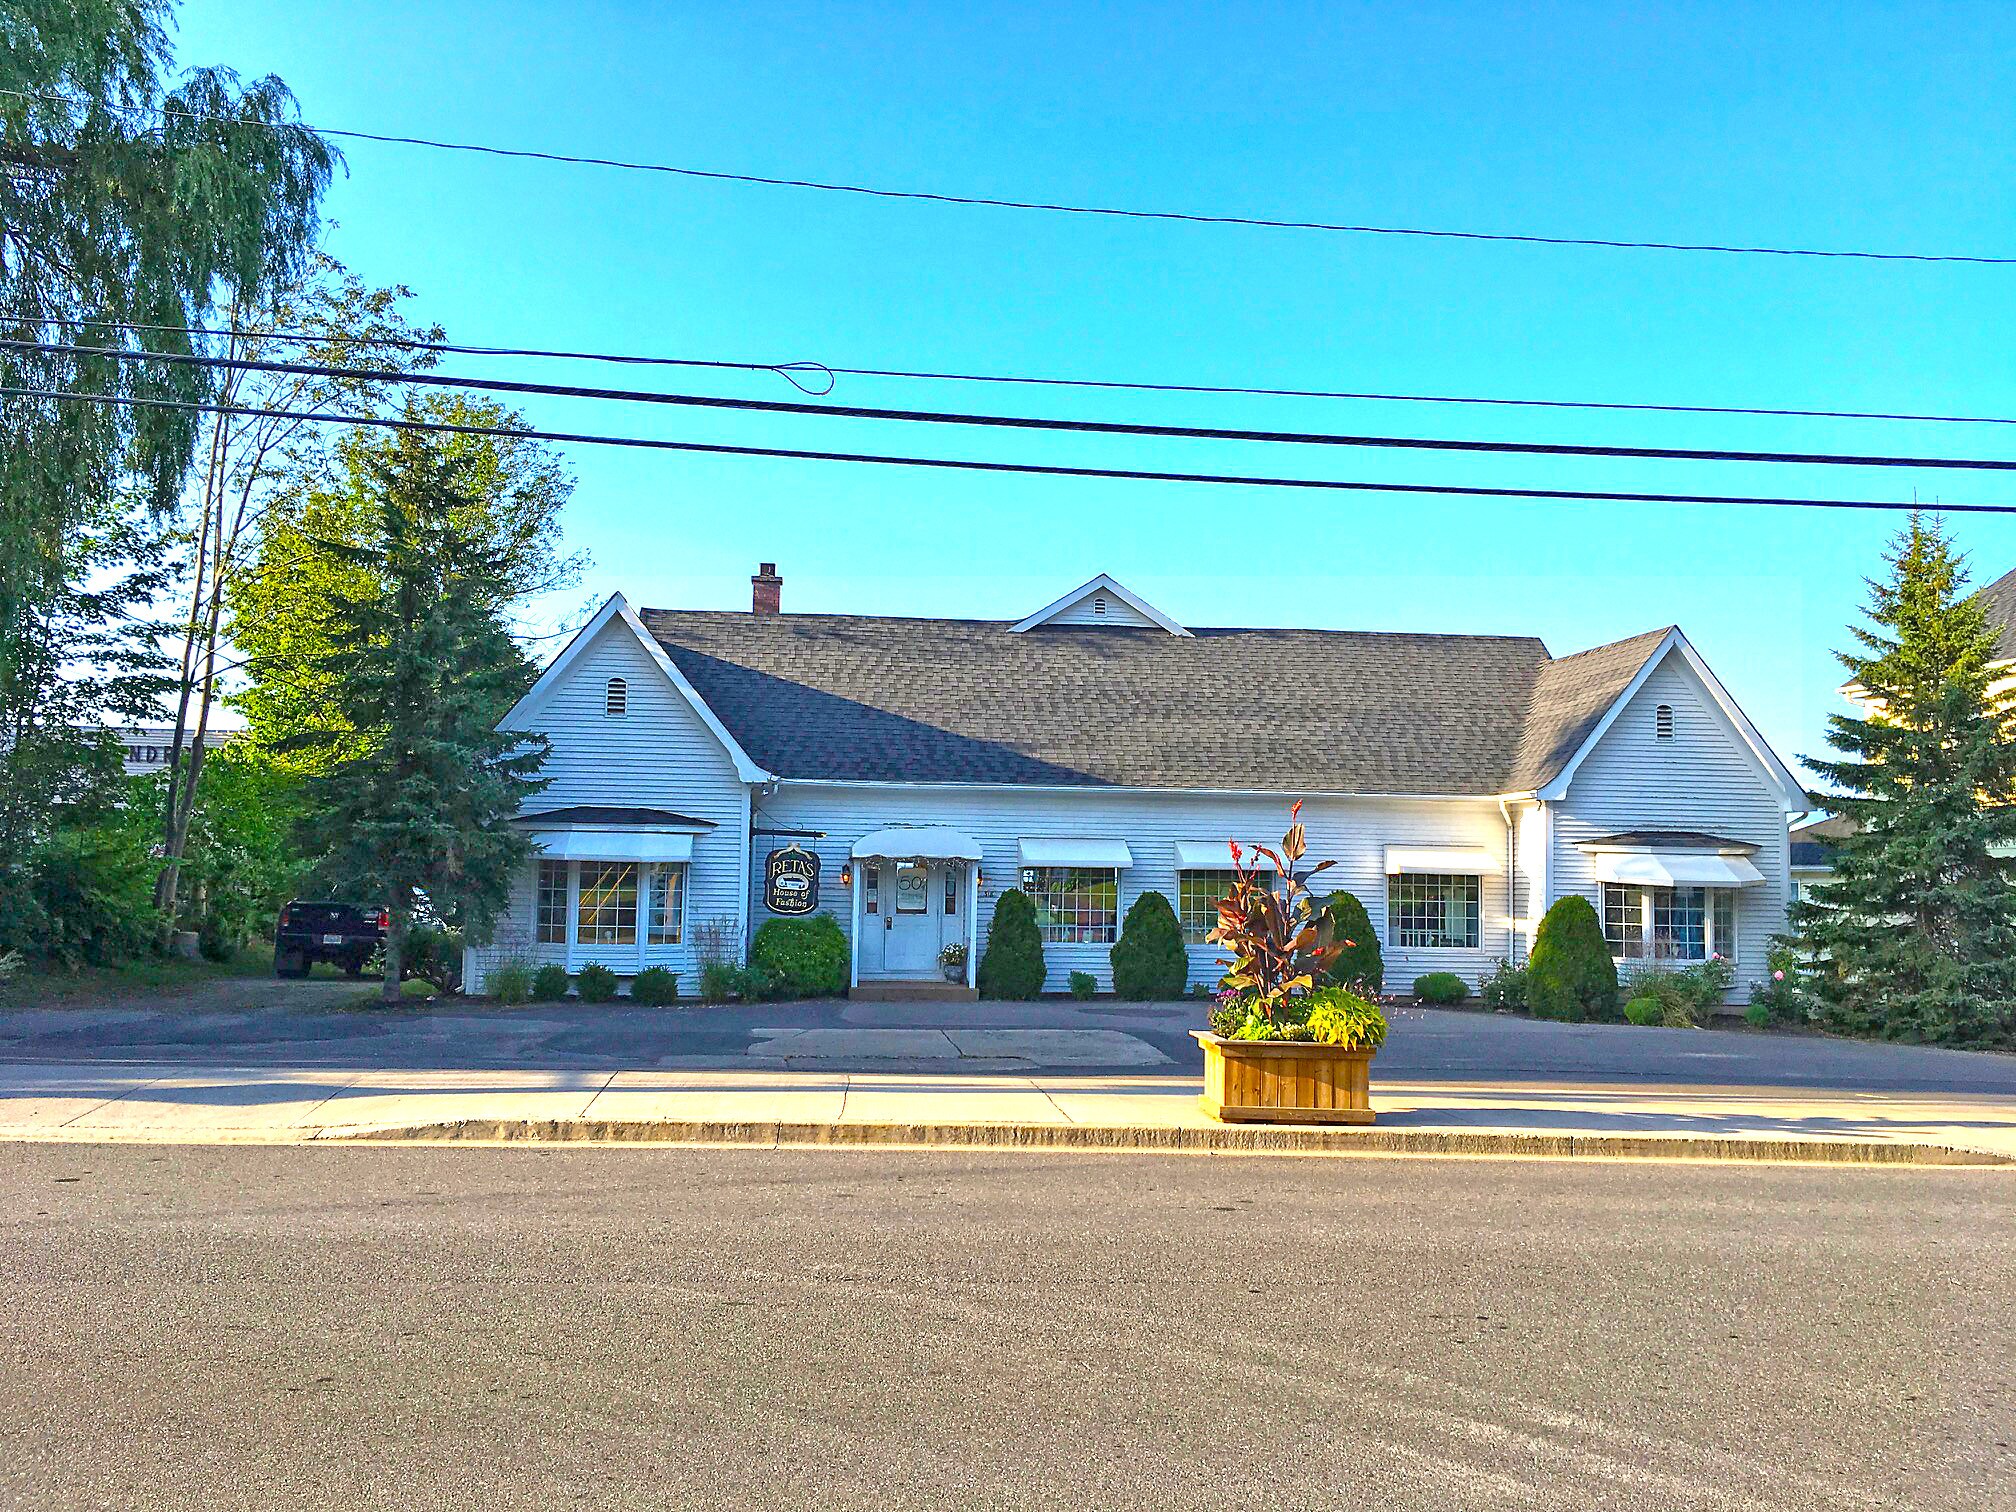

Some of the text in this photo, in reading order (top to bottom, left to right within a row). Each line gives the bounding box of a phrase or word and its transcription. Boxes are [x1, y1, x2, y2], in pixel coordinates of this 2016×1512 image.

[771, 860, 815, 880] RETA'S
[773, 888, 811, 900] House of
[776, 897, 807, 908] Fashion
